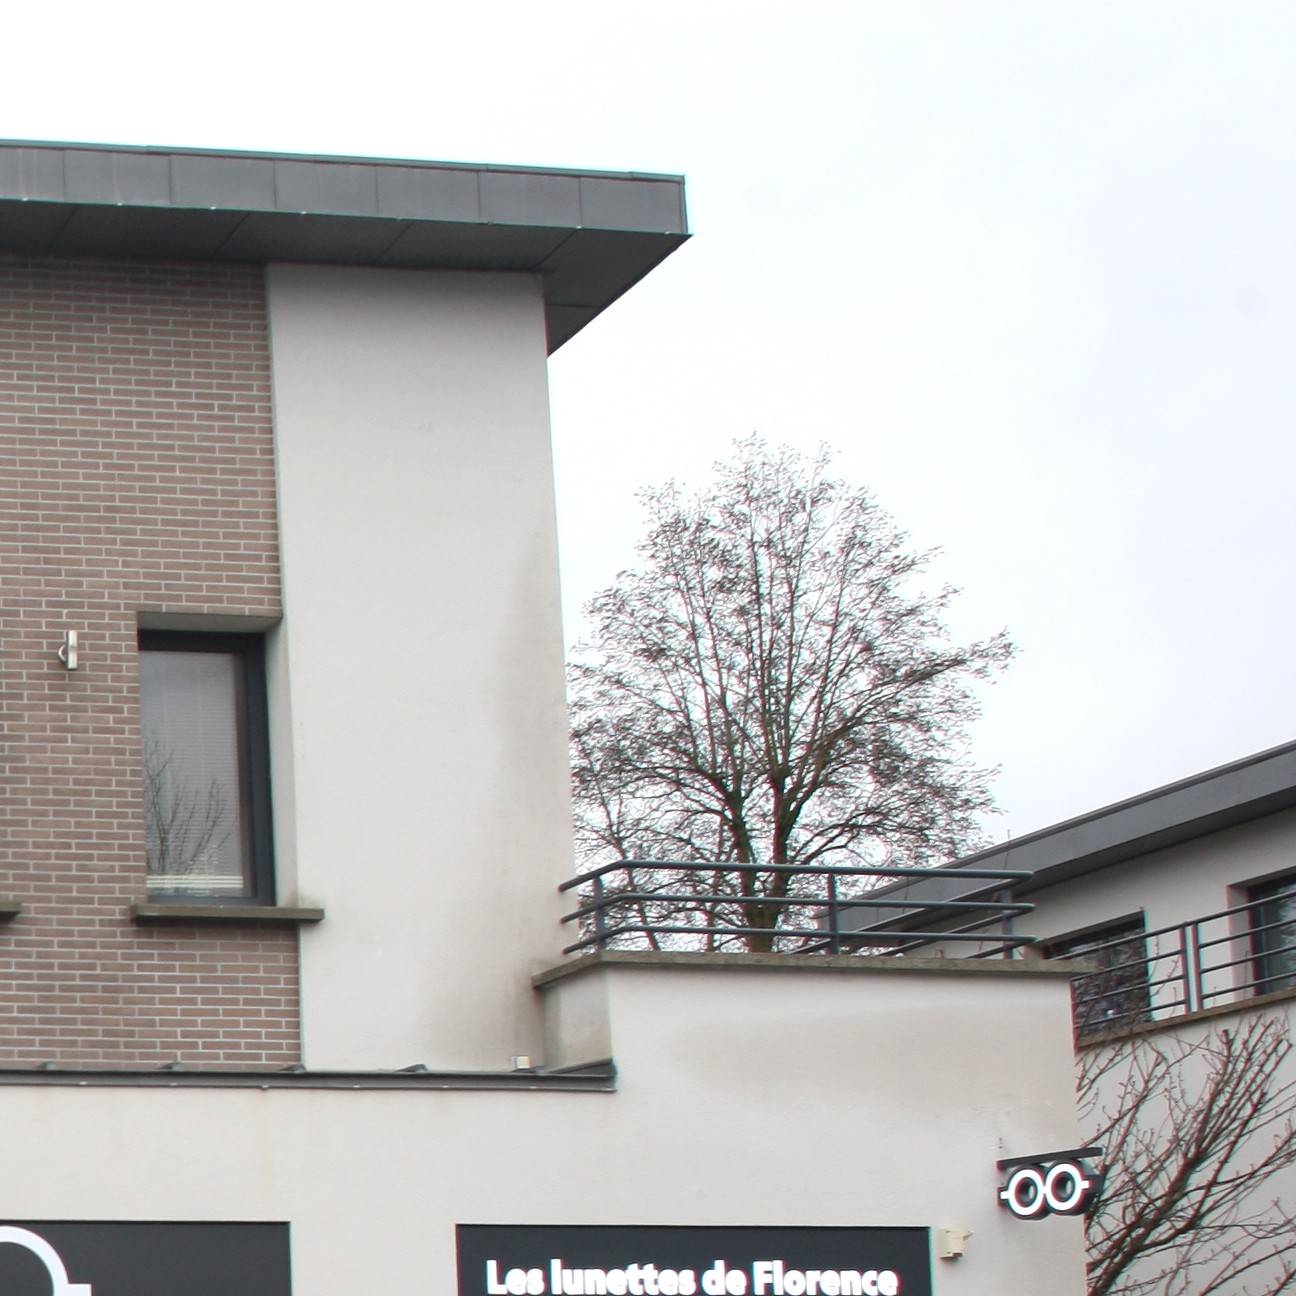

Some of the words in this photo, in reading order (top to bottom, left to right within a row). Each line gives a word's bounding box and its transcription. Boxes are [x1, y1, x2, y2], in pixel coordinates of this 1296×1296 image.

[486, 1259, 544, 1295] Les
[551, 1258, 695, 1295] lunettes
[702, 1260, 746, 1295] de
[754, 1260, 898, 1296] Florence
